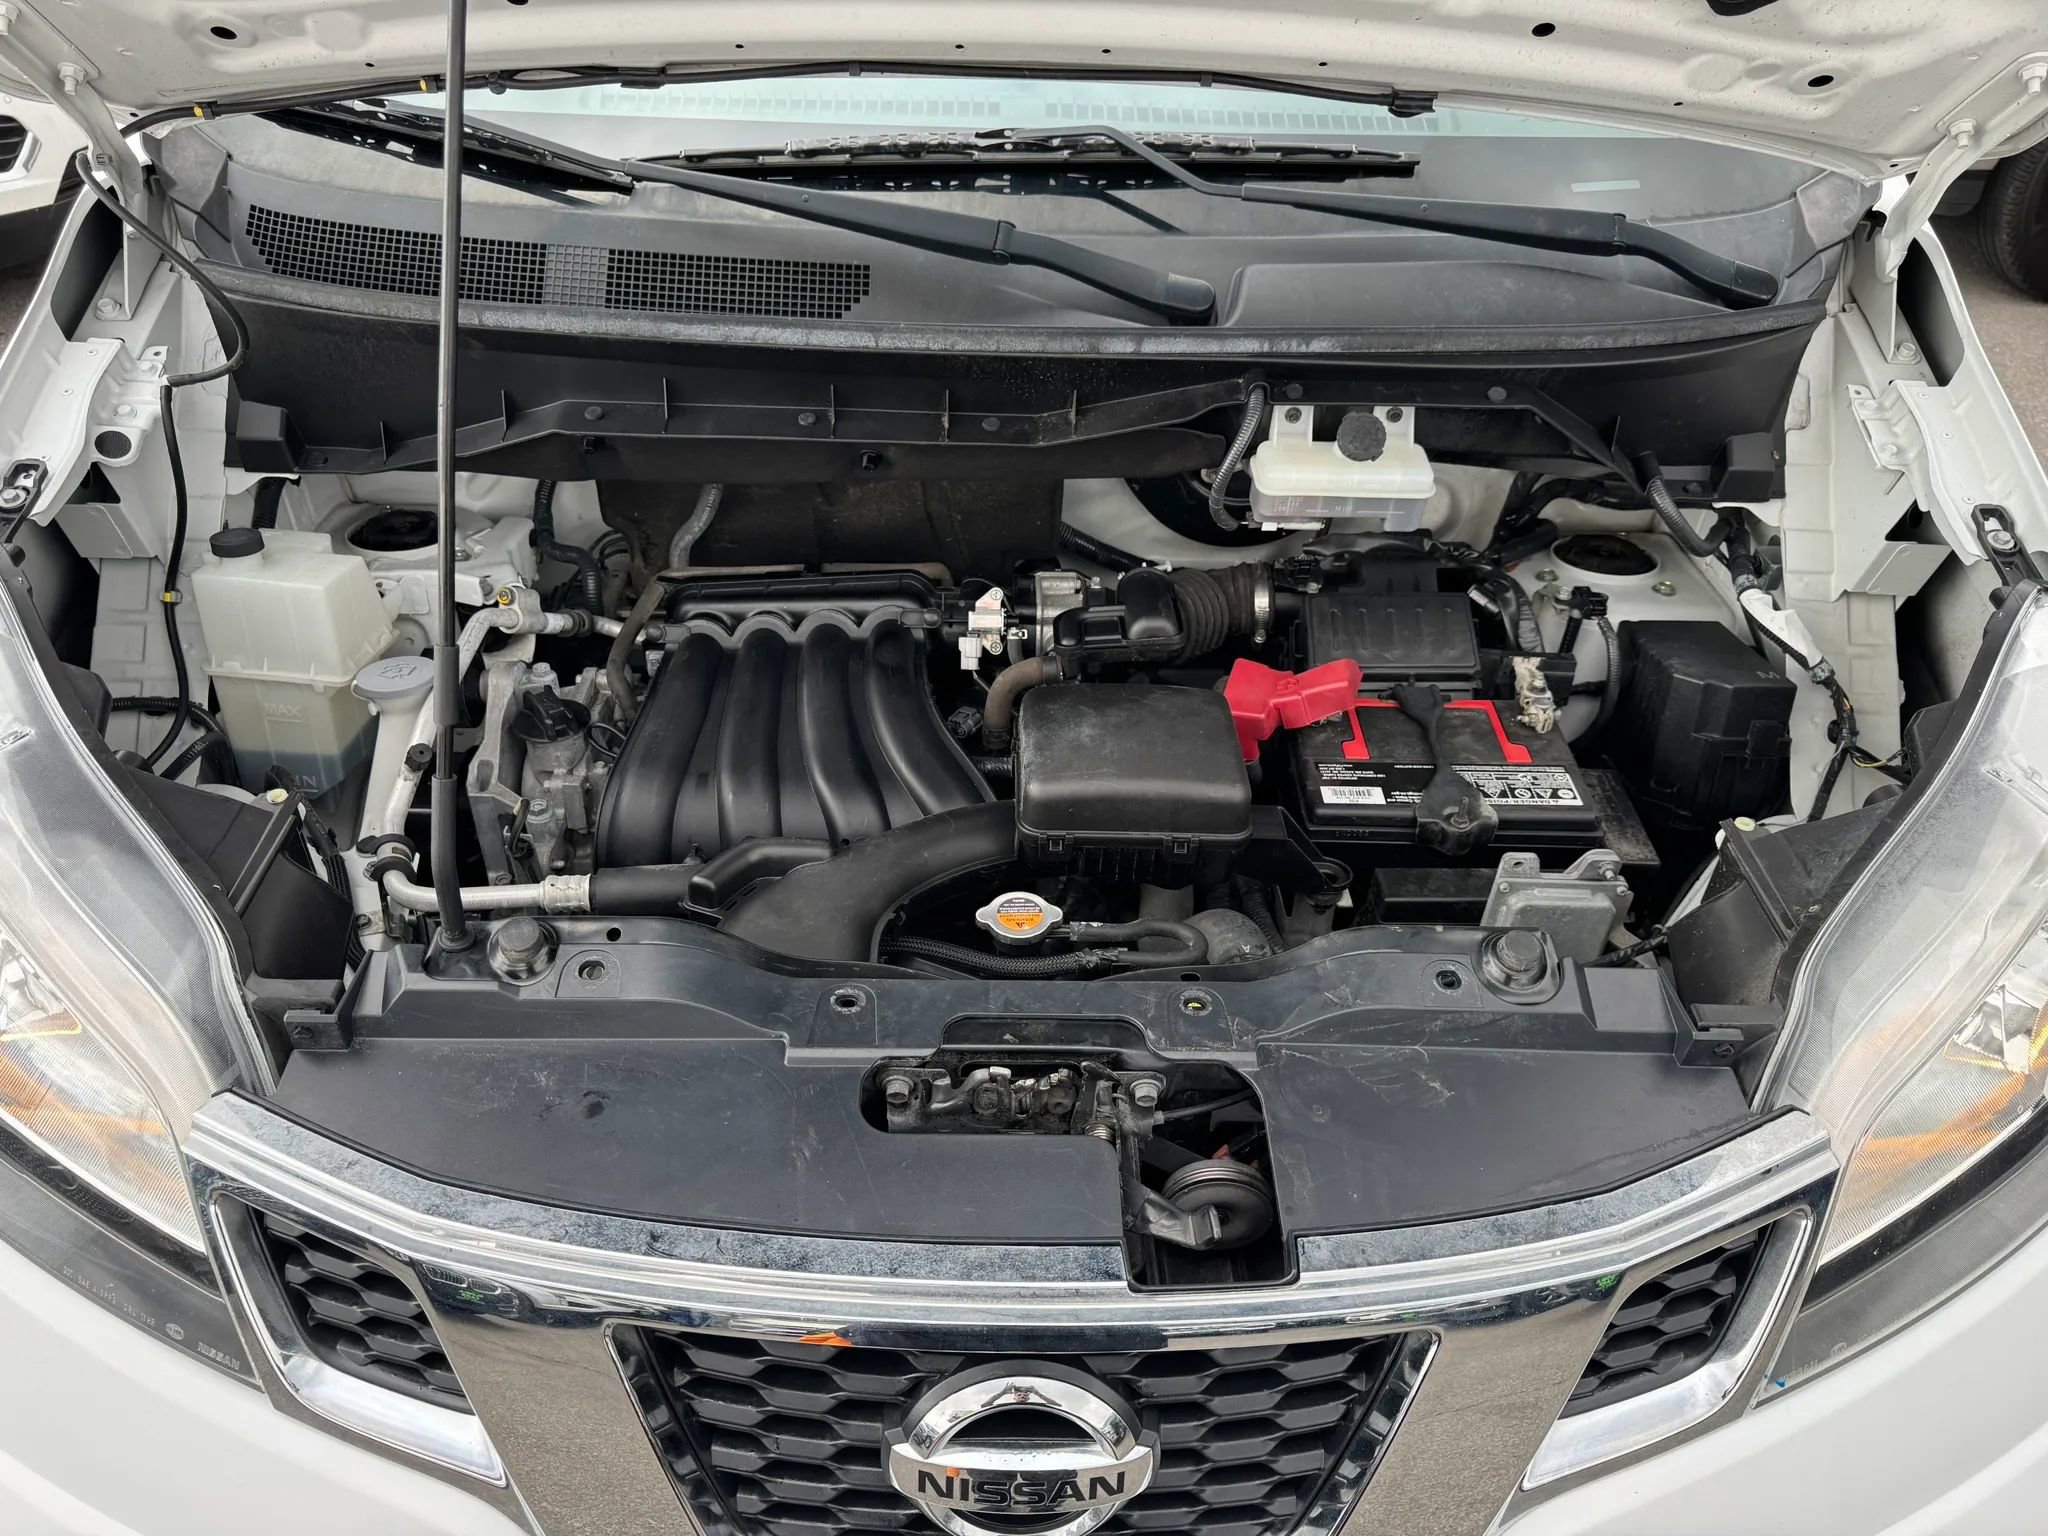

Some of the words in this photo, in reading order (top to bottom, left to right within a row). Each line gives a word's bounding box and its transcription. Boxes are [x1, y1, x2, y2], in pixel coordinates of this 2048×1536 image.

[264, 703, 302, 718] MAX
[295, 775, 318, 787] IN
[197, 1341, 240, 1370] NISSAN
[917, 1469, 1125, 1507] NISSAN
